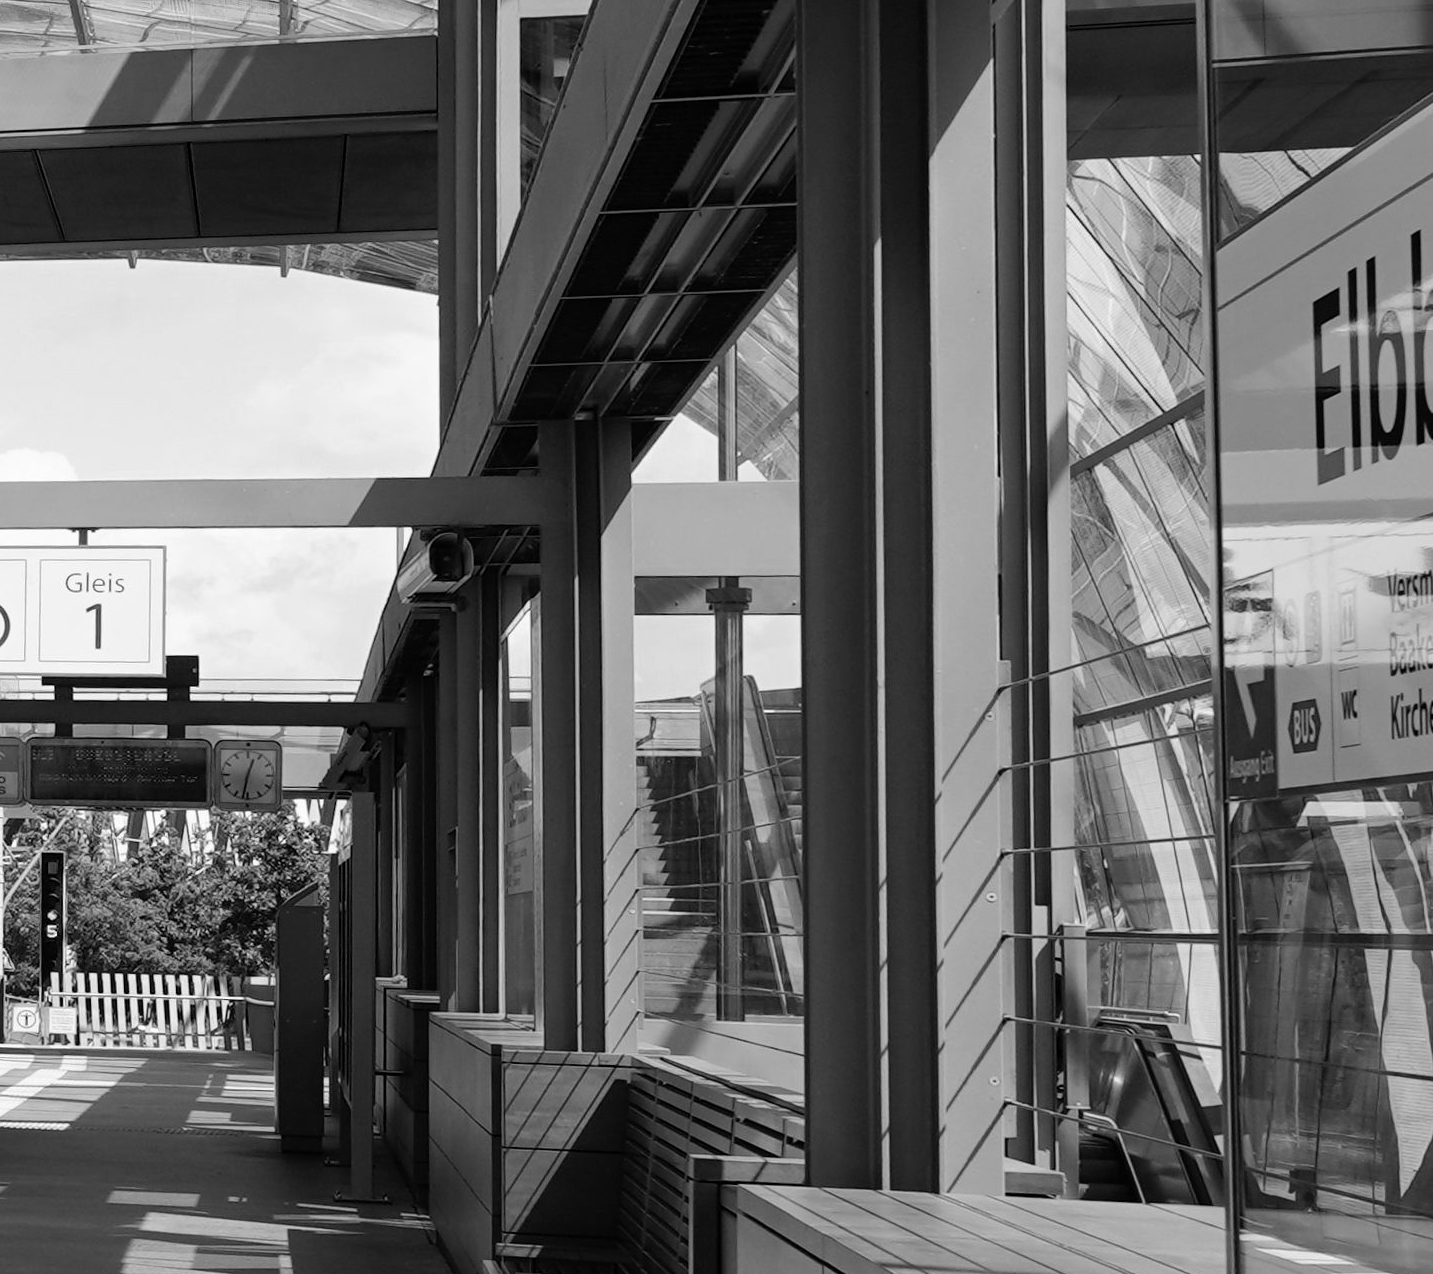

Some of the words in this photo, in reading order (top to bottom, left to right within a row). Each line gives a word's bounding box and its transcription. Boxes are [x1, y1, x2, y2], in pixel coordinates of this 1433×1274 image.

[65, 572, 125, 593] Gleis
[86, 603, 102, 649] 1
[1340, 689, 1358, 720] WC
[1293, 707, 1317, 745] BUS
[46, 924, 58, 939] 5
